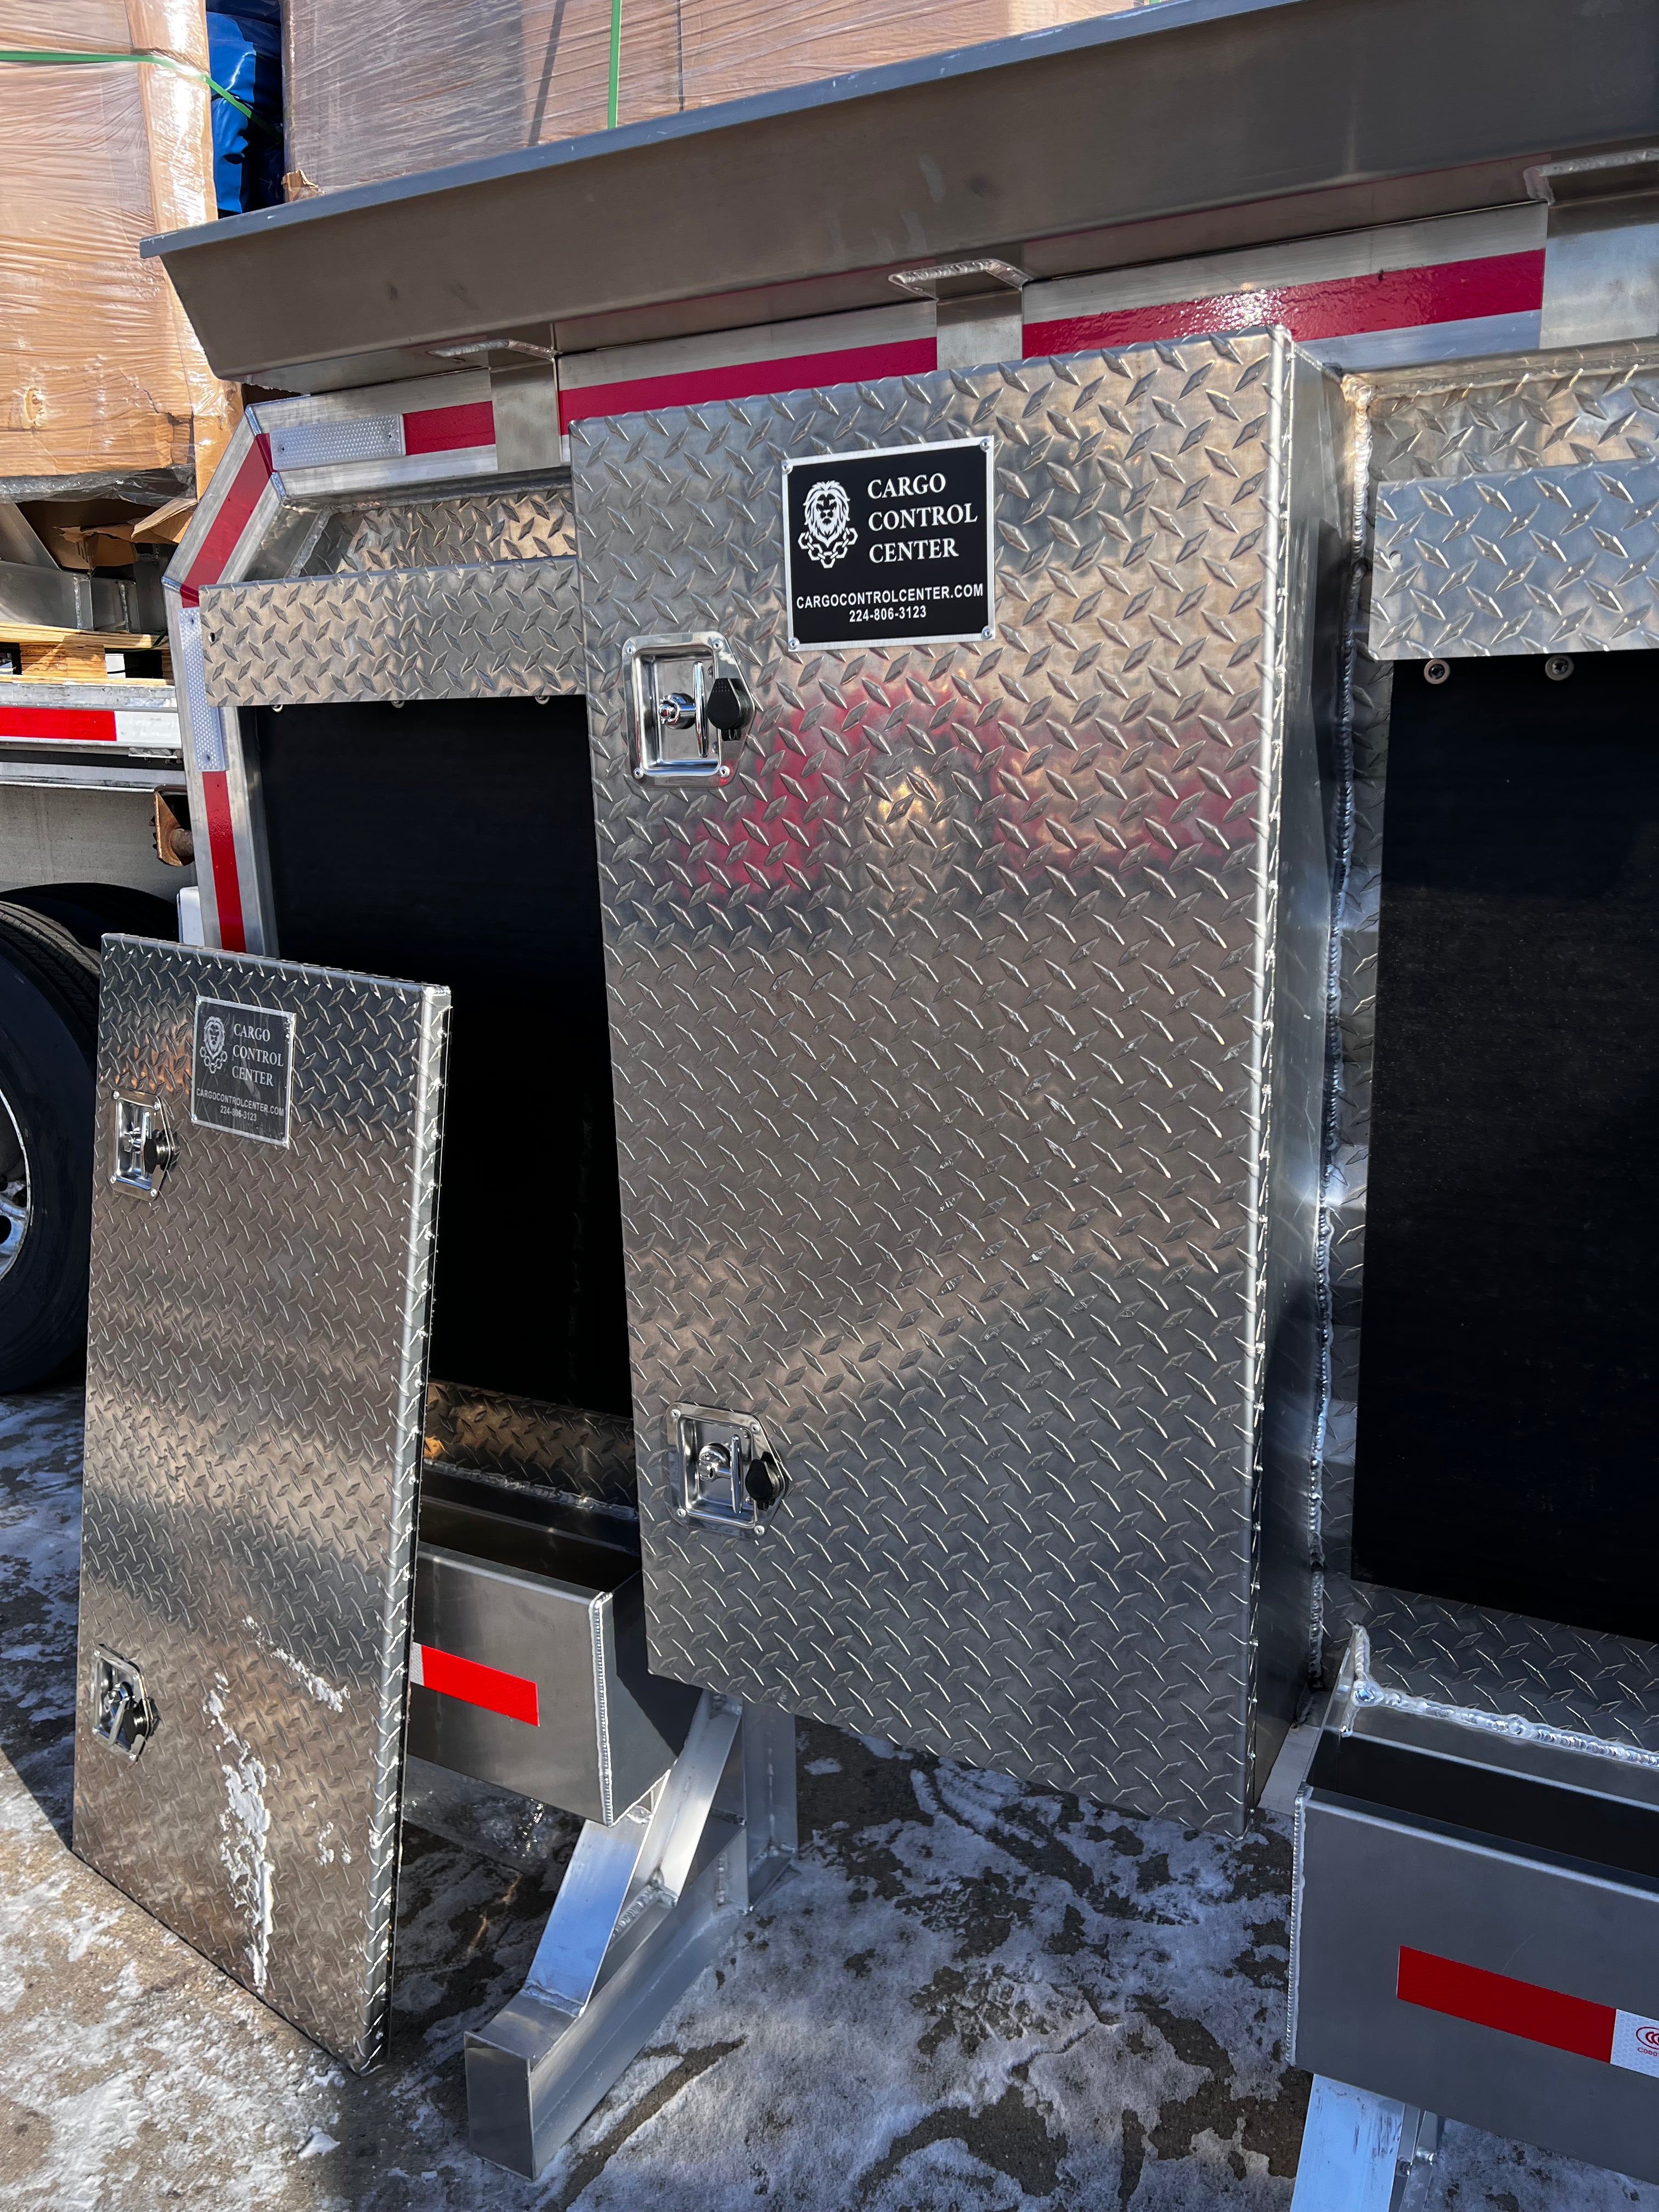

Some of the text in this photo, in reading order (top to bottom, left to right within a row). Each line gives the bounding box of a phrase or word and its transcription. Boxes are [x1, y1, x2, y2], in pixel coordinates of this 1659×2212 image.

[867, 473, 946, 499] CARGO
[868, 503, 978, 531] CONTROL
[869, 538, 958, 563] CENTER
[797, 583, 984, 609] CARGOCONTROLCENTER.COM
[849, 605, 927, 622] 224-806-3123
[233, 1023, 270, 1042] CARGO
[233, 1045, 284, 1067] CONTROL
[232, 1066, 274, 1087] CENTER
[196, 1088, 284, 1116] CARGOCONTROLCENTER.COM
[220, 1105, 257, 1122] 224-806-3123
